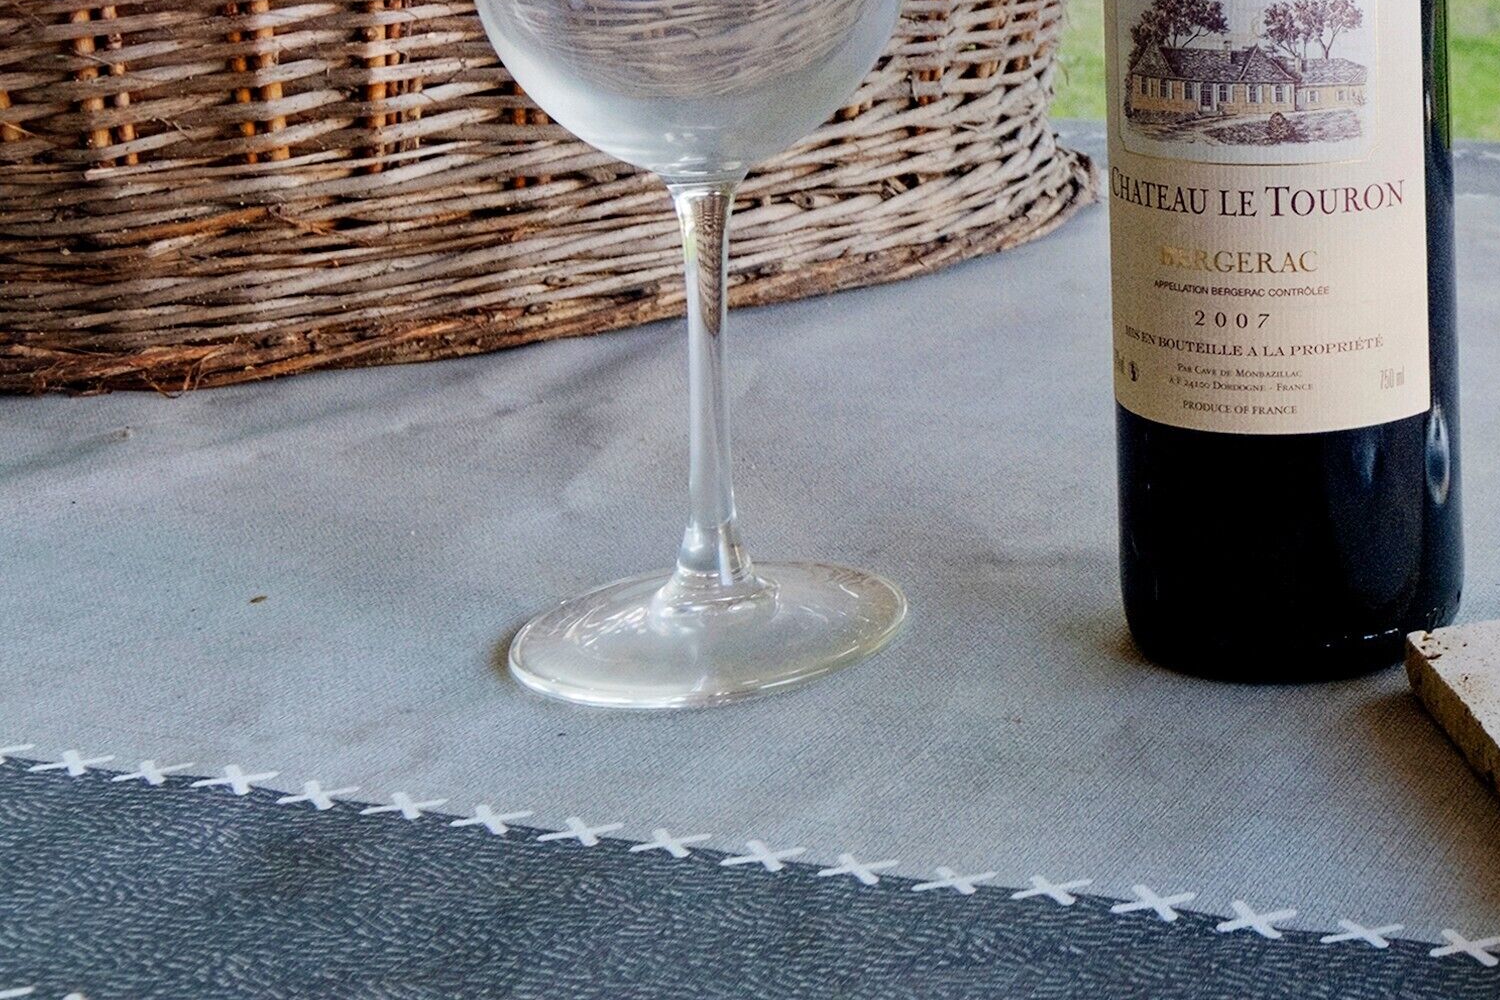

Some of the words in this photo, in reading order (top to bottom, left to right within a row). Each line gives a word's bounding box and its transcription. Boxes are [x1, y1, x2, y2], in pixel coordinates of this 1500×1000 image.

[1111, 167, 1208, 214] CHATEAU
[1218, 190, 1258, 217] LE
[1265, 179, 1406, 217] TOURON
[1159, 248, 1320, 275] BERGERAC
[1154, 280, 1209, 295] APPELLATION
[1211, 287, 1266, 298] BERGERAC
[1268, 284, 1331, 298] CONTRÔLÉE
[1194, 310, 1271, 329] 2007
[1158, 337, 1243, 357] BOUTEILLE
[1263, 345, 1286, 357] LA
[1290, 334, 1385, 357] PROPRIÉTÉ
[1182, 399, 1232, 414] PRODUCE
[1233, 405, 1250, 415] OF
[1251, 405, 1299, 416] FRANCE
